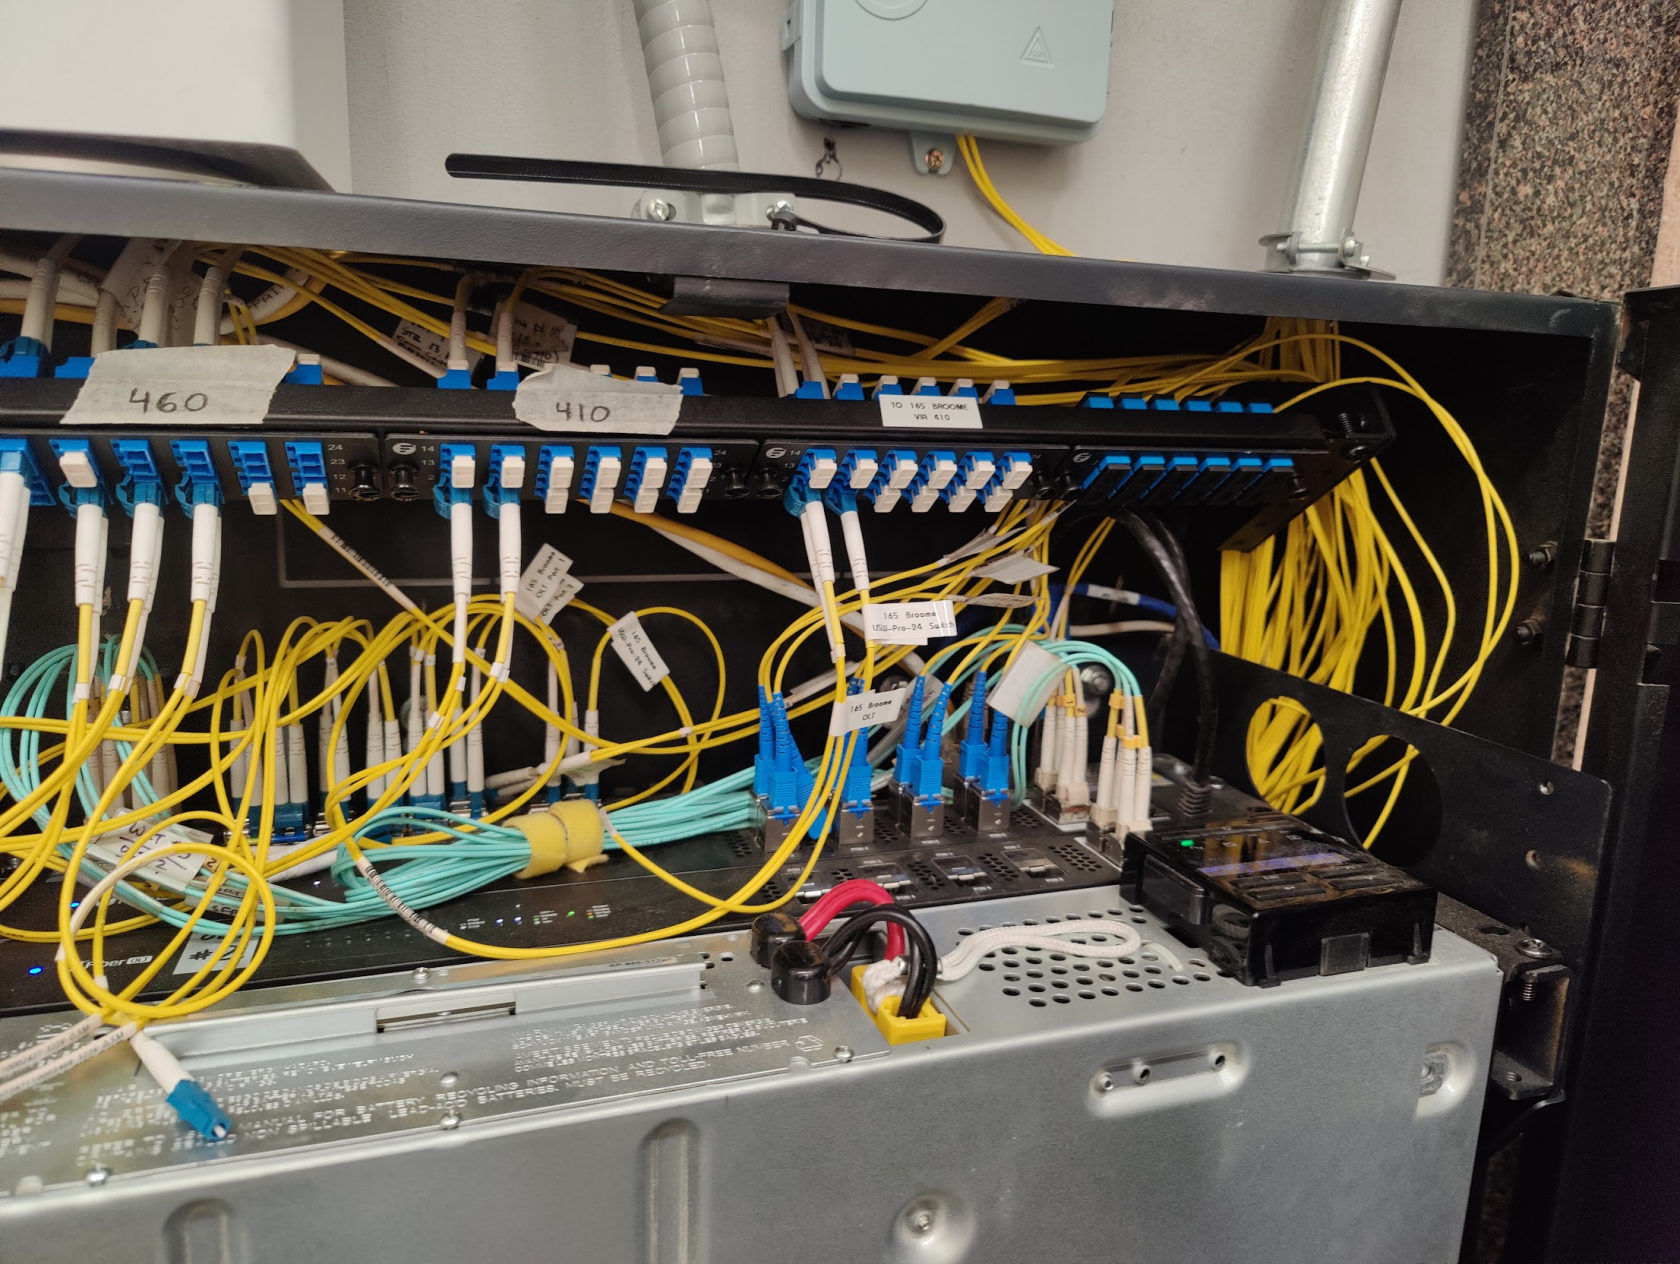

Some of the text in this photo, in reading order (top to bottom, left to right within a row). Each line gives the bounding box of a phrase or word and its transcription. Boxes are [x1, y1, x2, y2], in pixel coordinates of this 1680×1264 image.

[129, 388, 208, 413] 460
[910, 402, 926, 410] 165
[932, 403, 969, 411] BROOME
[556, 401, 610, 422] 410
[913, 413, 928, 421] VIA
[905, 611, 937, 619] Broome
[872, 620, 955, 632] USW-Pro-24 Switch
[641, 646, 657, 670] Broome
[850, 700, 892, 713] 165 Broome
[862, 712, 875, 721] OLT
[313, 1108, 346, 1120] FOR
[356, 1096, 426, 1115] BATTERY
[435, 1082, 519, 1101] RECYCLING
[526, 1066, 619, 1087] INFORMATION
[628, 1060, 655, 1071] AND
[659, 1048, 734, 1065] TOLL-FREE
[736, 1039, 791, 1053] NUMBER
[388, 1098, 469, 1119] LEAD-ACID
[477, 1084, 559, 1105] BATTERIES.
[565, 1076, 604, 1088] MUST
[610, 1072, 630, 1082] BE
[635, 1060, 711, 1077] RECYCLED.
